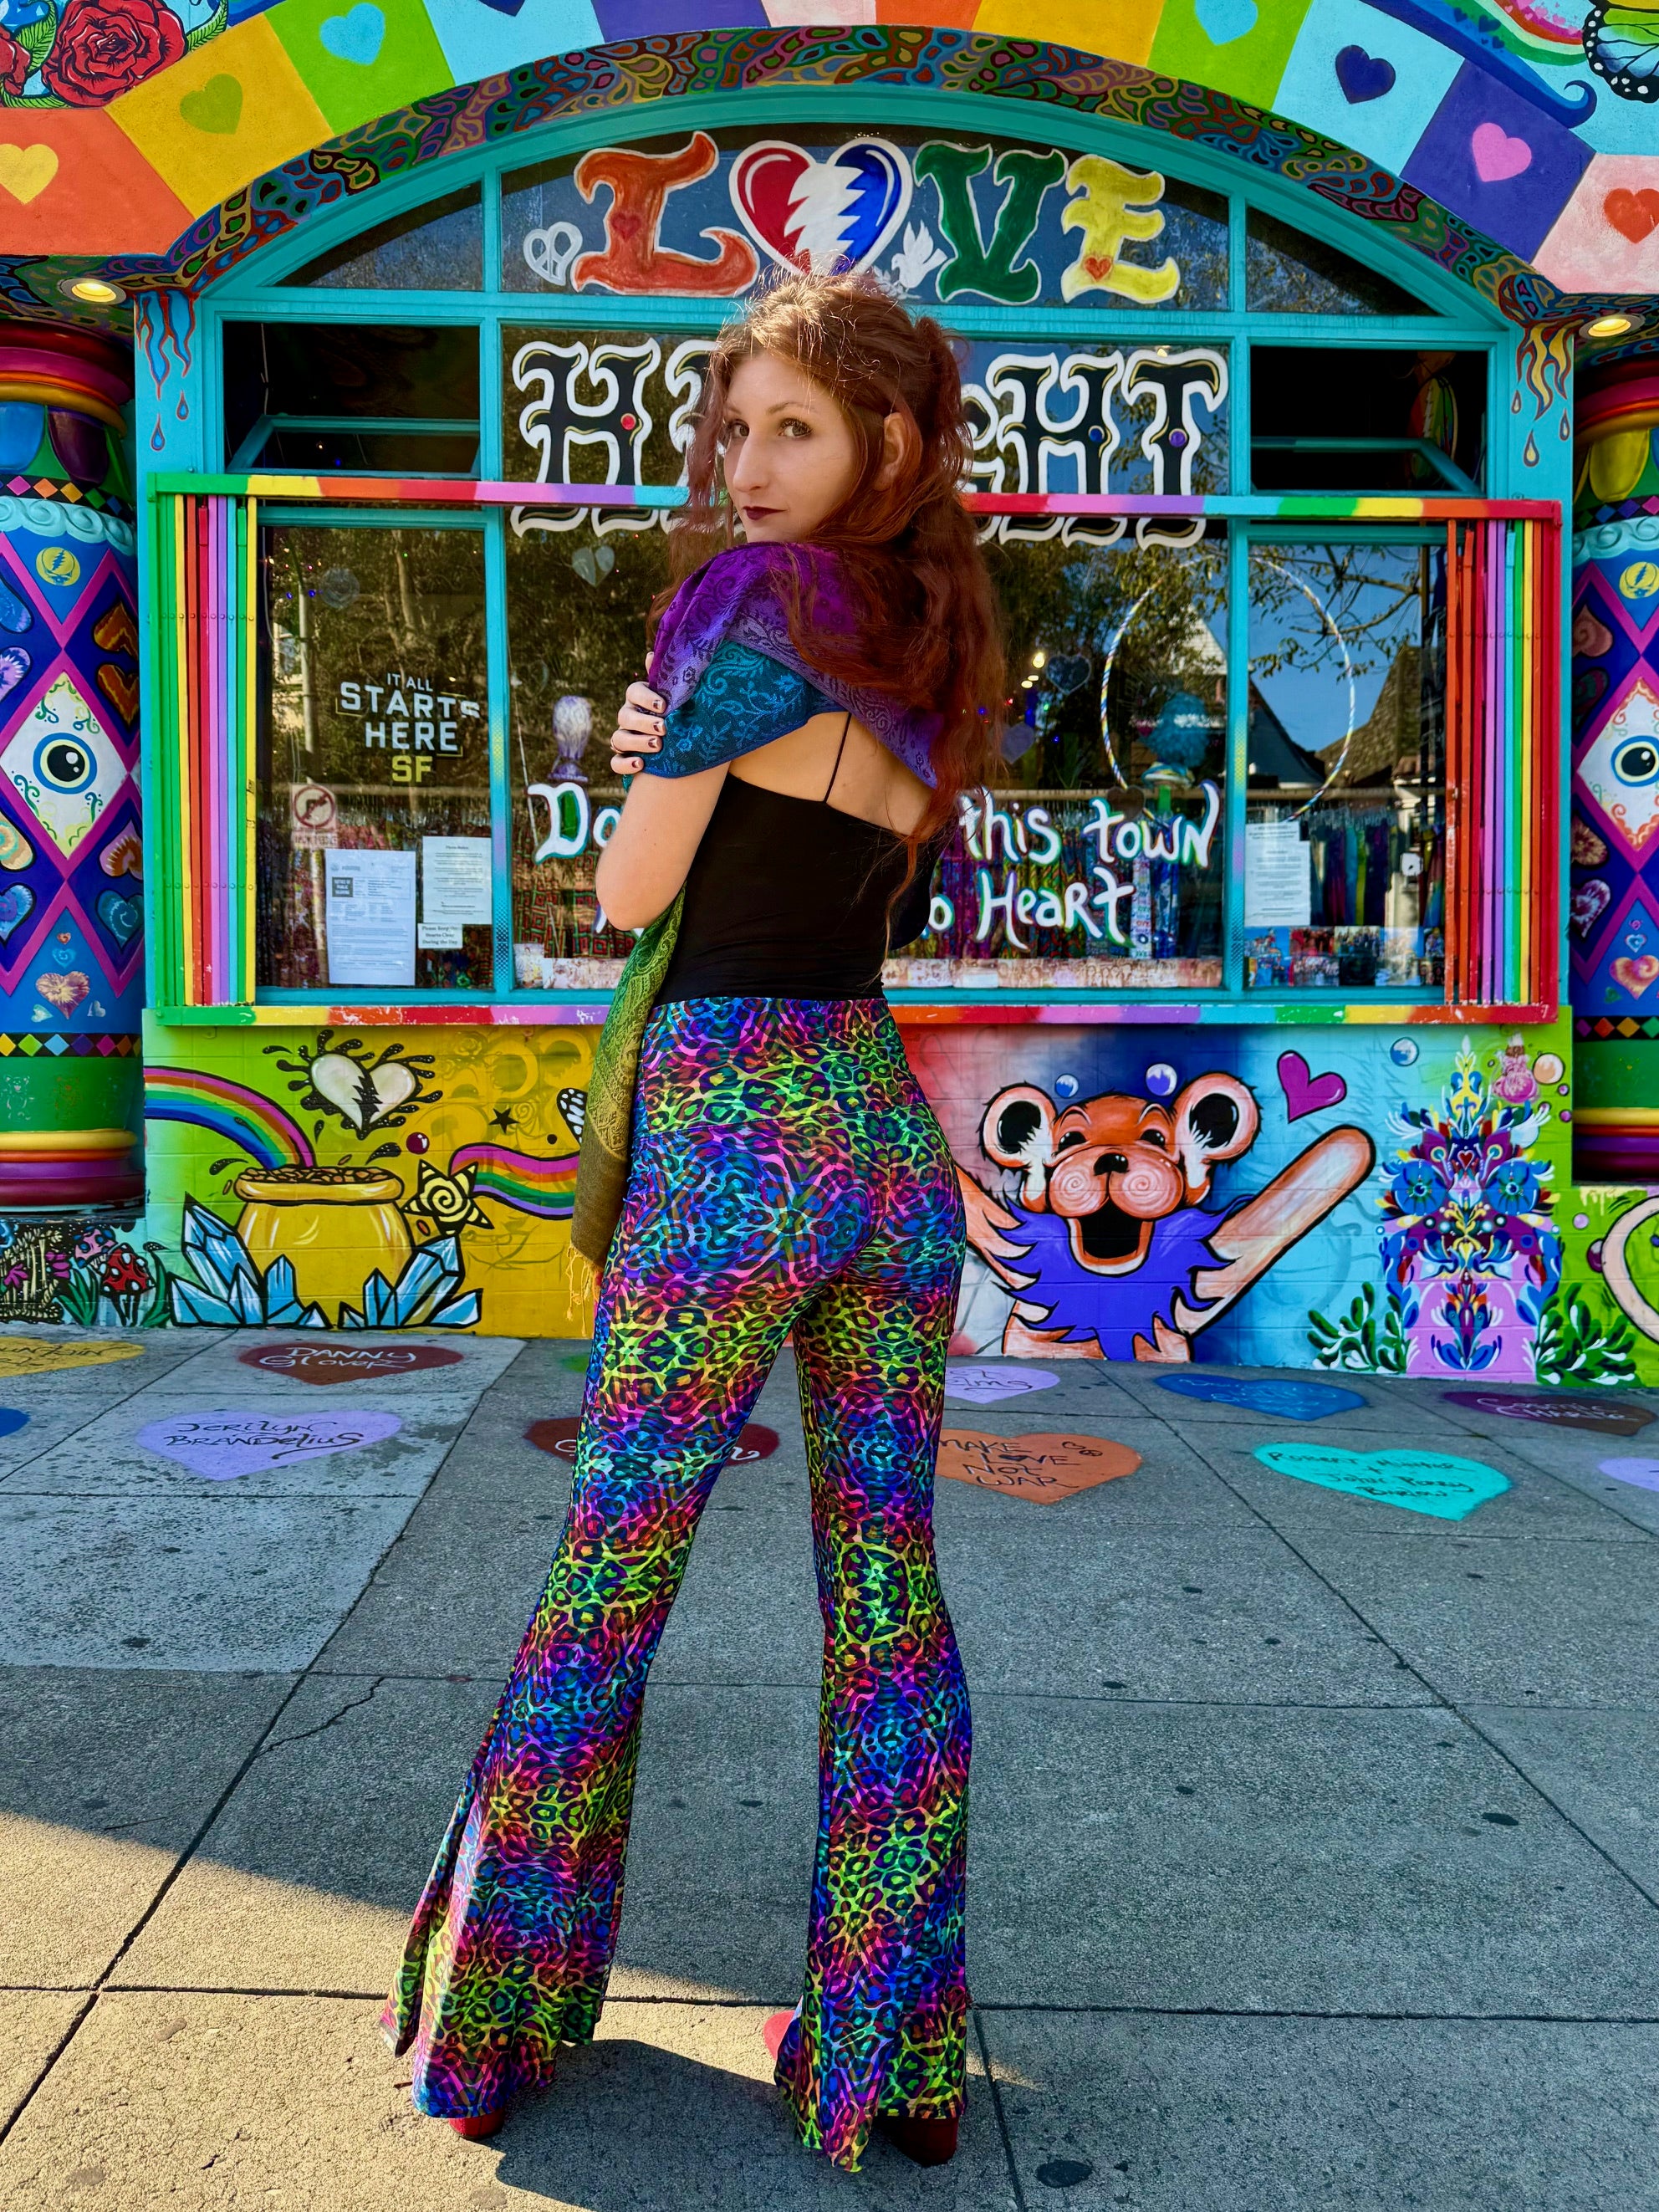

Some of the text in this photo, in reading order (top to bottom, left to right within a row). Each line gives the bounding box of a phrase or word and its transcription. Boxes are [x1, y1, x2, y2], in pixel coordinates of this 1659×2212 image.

[386, 672, 434, 692] IT ALL
[339, 681, 481, 719] STARTS
[365, 721, 458, 752] HERE
[391, 754, 433, 783] SF
[958, 784, 1063, 866] this
[285, 1346, 416, 1363] DANNY
[938, 1438, 1033, 1453] MAKE
